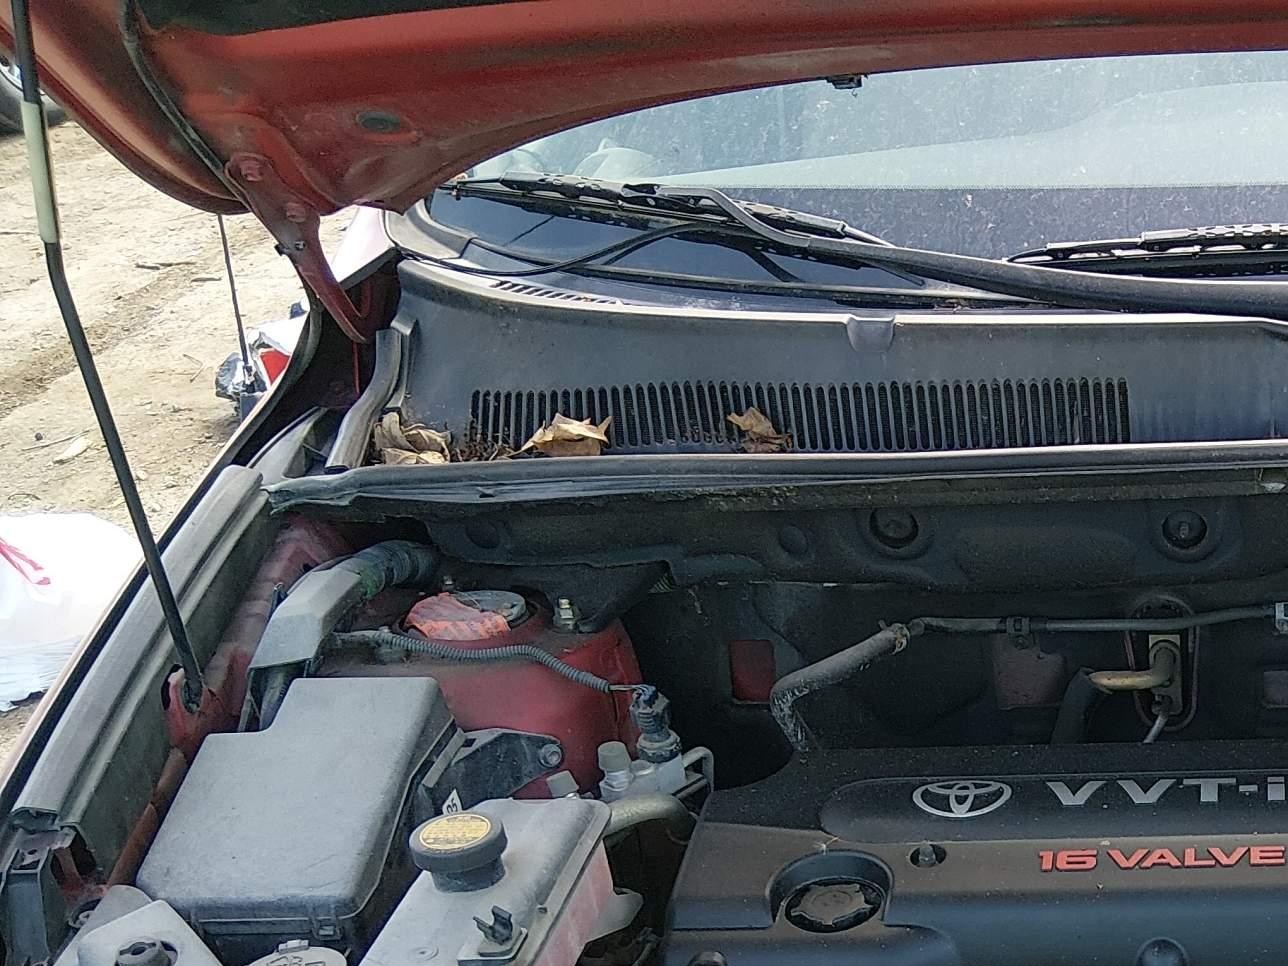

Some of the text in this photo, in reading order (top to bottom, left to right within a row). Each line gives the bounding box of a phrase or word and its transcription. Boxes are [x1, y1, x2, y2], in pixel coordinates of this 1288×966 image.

[1046, 776, 1285, 806] VVT-i
[1039, 846, 1286, 872] 16 VALVE
